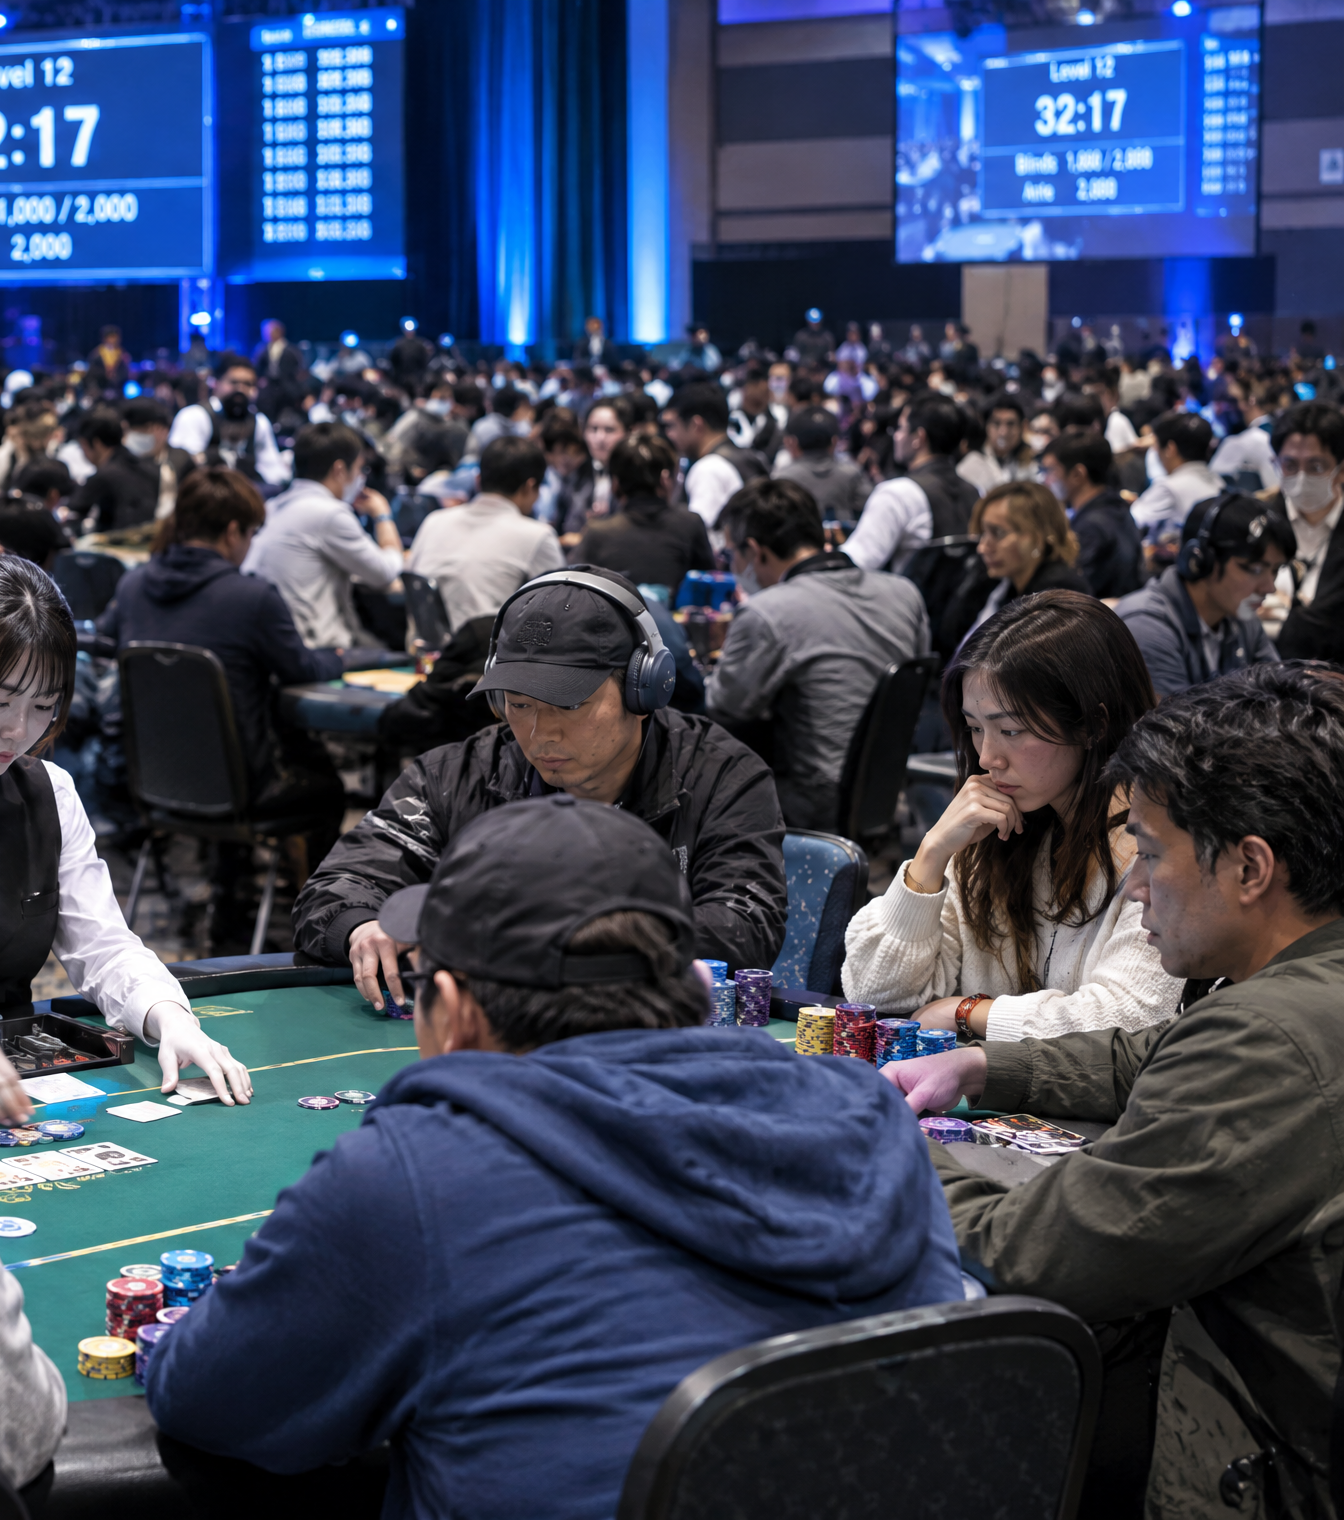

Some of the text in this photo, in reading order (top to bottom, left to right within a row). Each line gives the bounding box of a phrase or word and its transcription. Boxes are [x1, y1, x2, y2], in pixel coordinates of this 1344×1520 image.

[40, 55, 75, 87] 12
[1049, 54, 1116, 83] Level 12
[1034, 87, 1128, 137] 32:17
[74, 192, 138, 226] 2,000
[10, 232, 73, 264] 2,000
